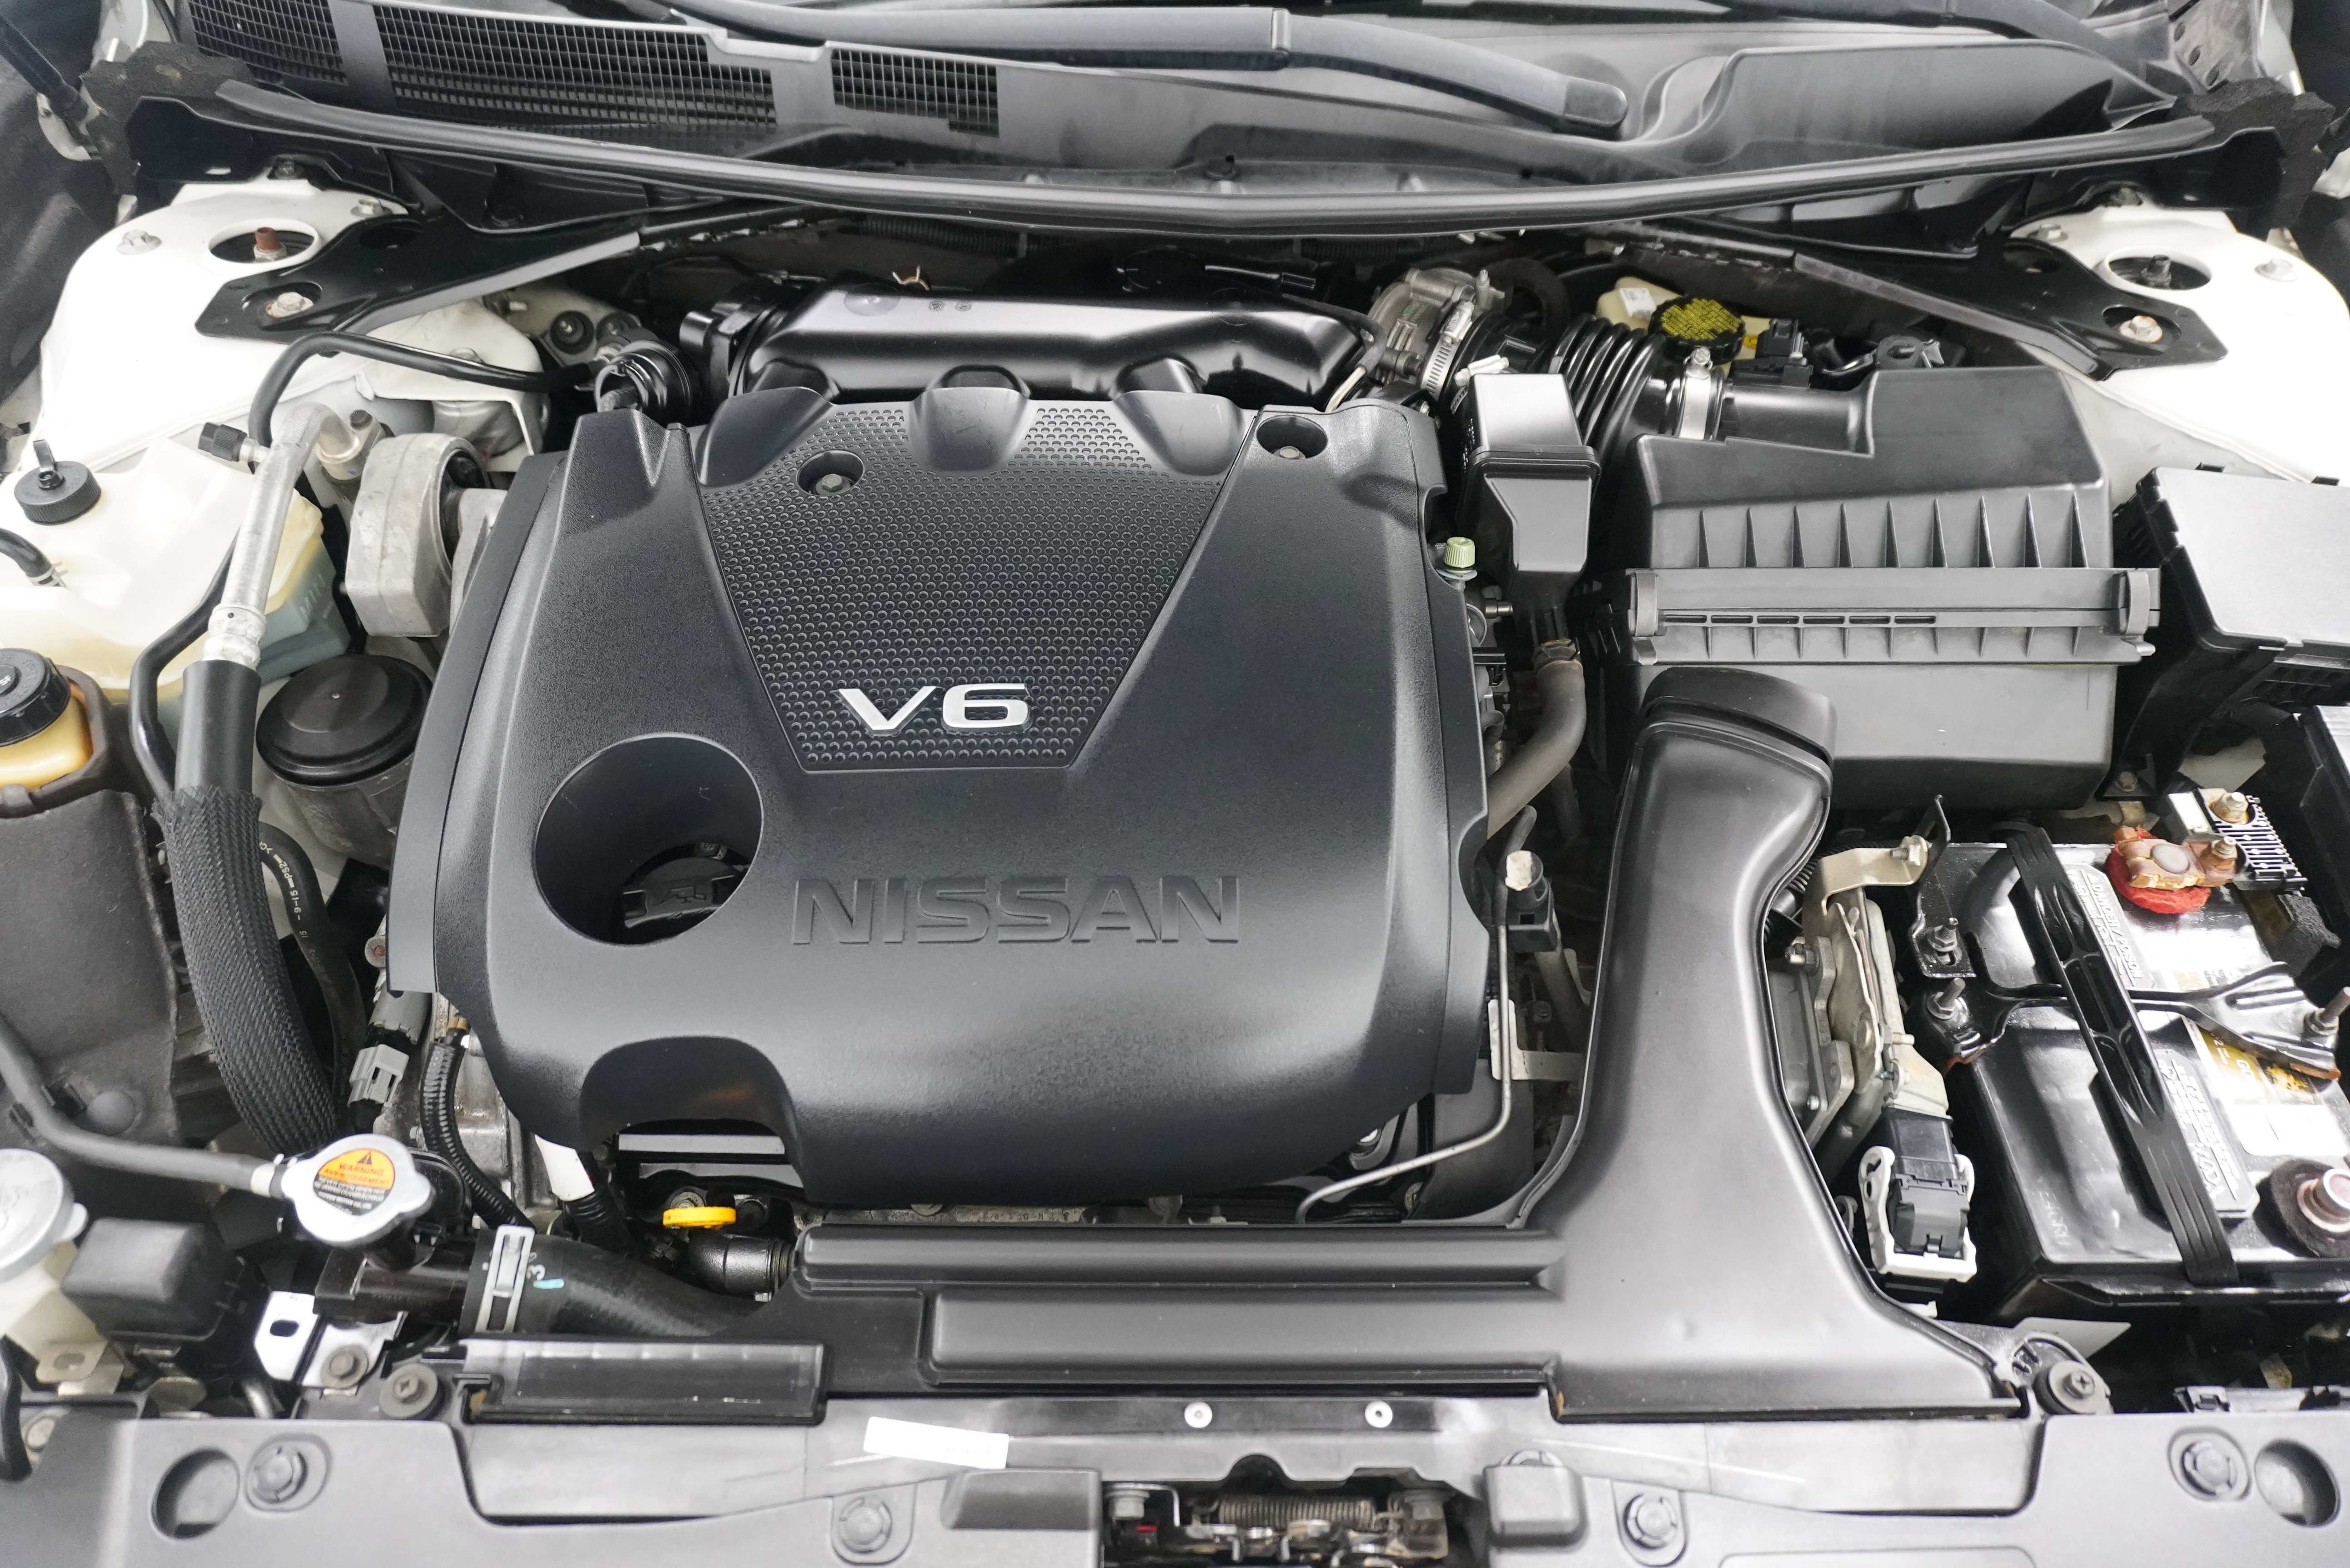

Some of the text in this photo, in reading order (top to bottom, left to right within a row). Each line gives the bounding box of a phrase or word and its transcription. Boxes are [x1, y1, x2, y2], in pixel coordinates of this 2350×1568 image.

[839, 683, 1029, 730] V6
[792, 877, 1240, 944] NISSAN
[2092, 885, 2120, 928] DANGER
[2116, 937, 2144, 978] POISON
[339, 1163, 384, 1176] WARNING
